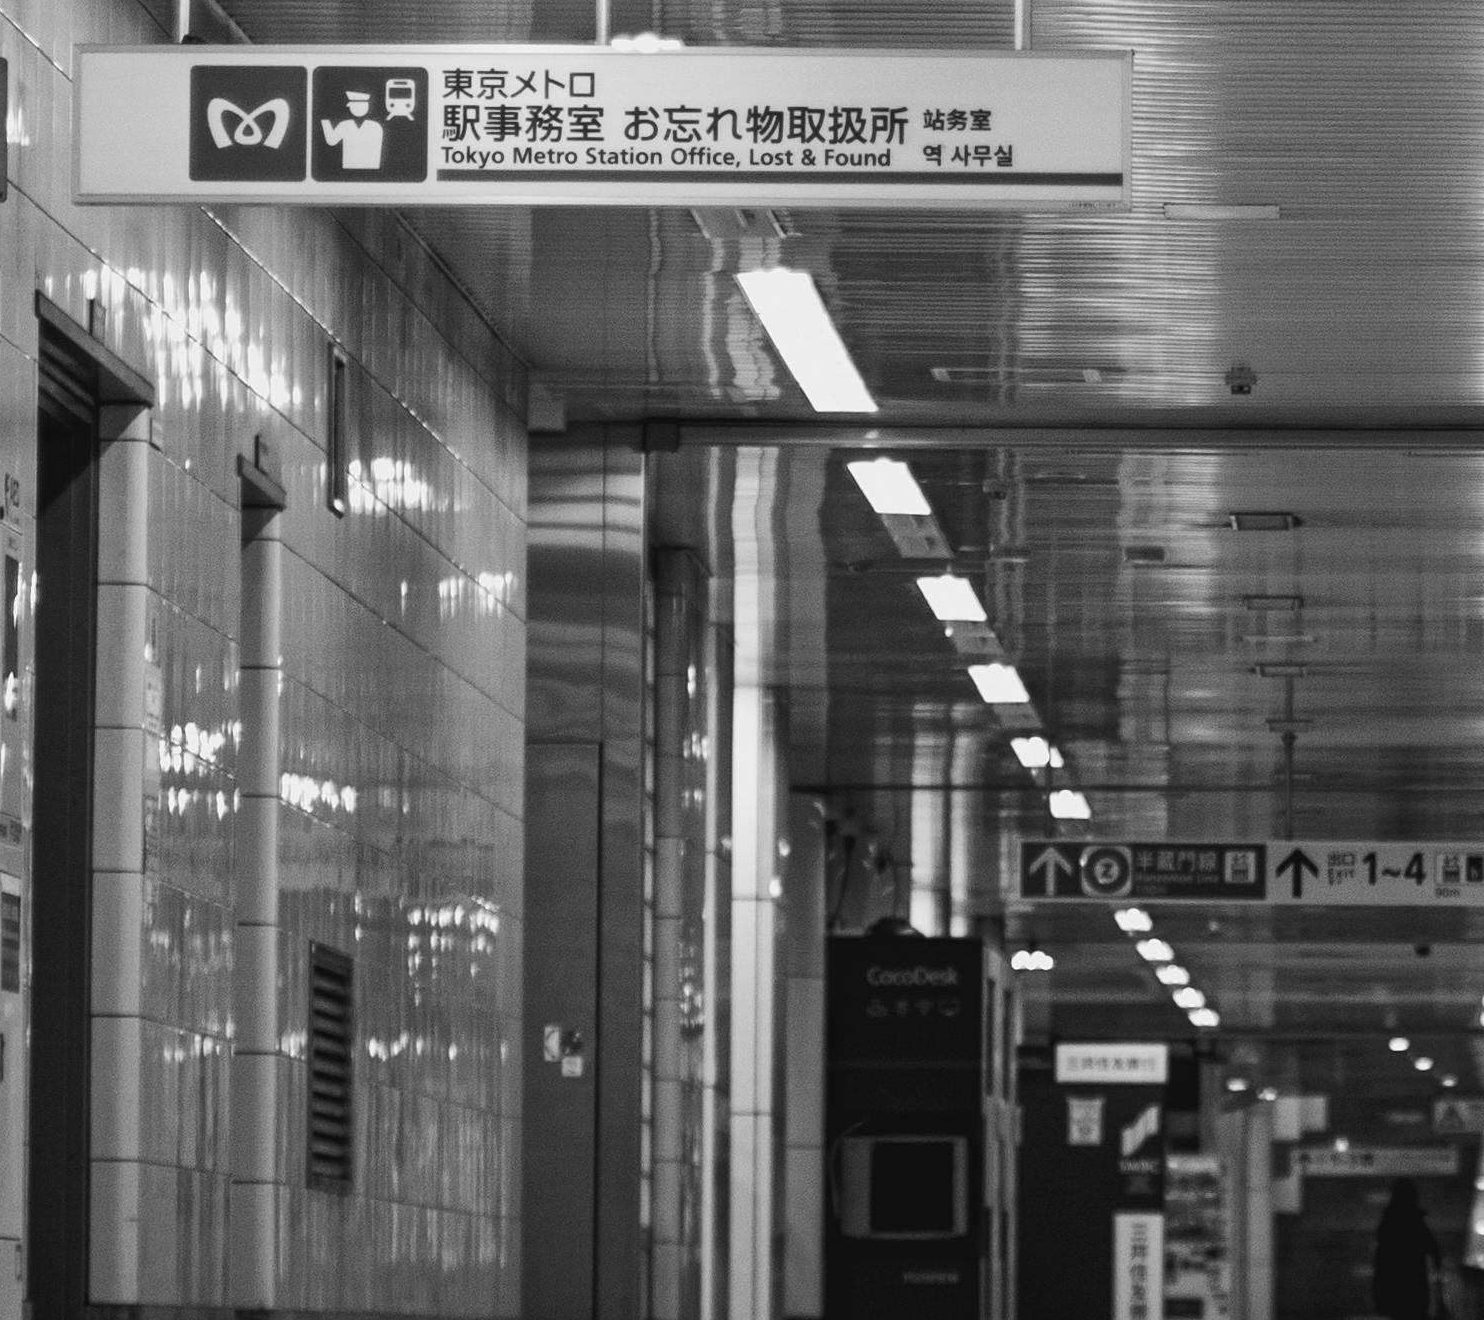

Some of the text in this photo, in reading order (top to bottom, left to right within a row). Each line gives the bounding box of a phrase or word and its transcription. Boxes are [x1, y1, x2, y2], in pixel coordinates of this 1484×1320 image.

[442, 68, 595, 99] 東京メトロ
[442, 104, 909, 145] 駅事務室 お忘れ物取扱所
[922, 109, 992, 131] 站务室
[441, 146, 891, 168] Tokyo Metro Station Office, Lost & Found
[922, 144, 1013, 167] 역 사무실
